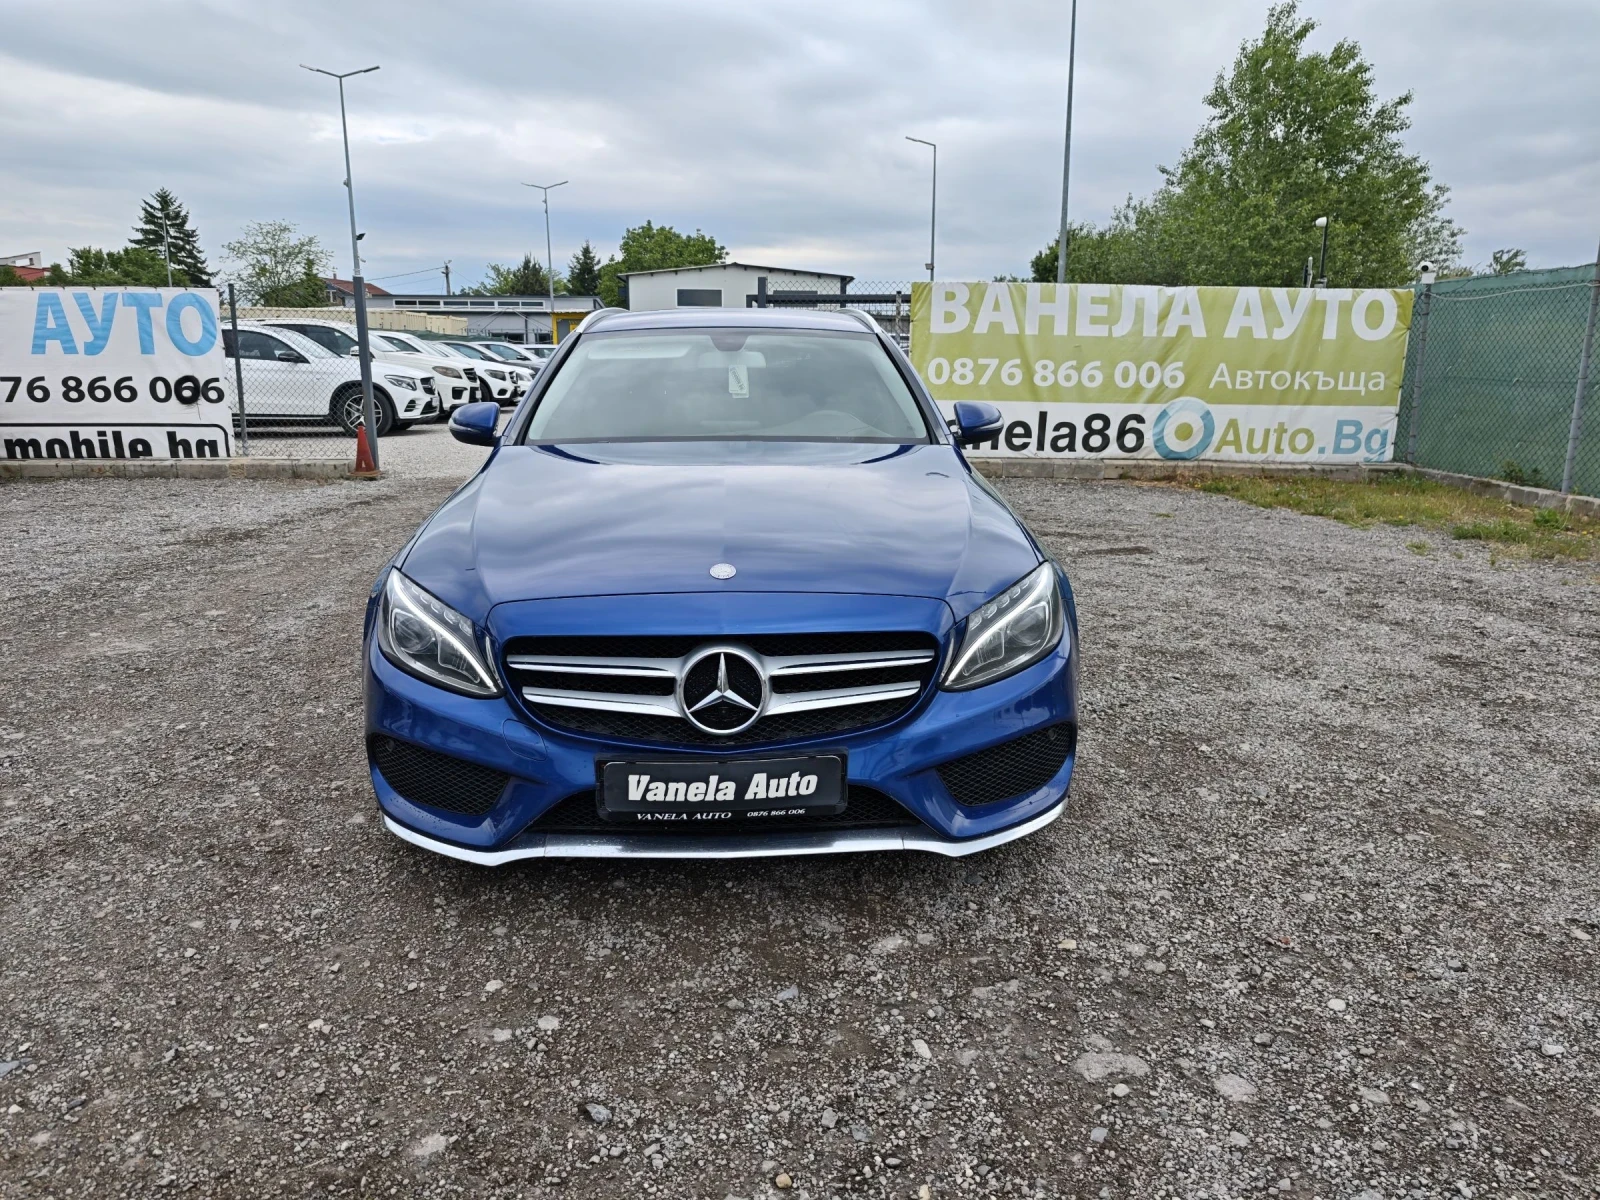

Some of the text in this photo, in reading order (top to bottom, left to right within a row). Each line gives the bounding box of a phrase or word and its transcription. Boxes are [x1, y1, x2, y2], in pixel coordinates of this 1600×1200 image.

[31, 292, 218, 356] АУТО
[929, 282, 1398, 341] ВАНЕЛА АУТО
[61, 376, 138, 403] 866
[927, 357, 1185, 389] 0876 866 006
[1208, 362, 1386, 396] Автокъща
[1212, 418, 1389, 463] Auto.Bg
[628, 771, 818, 802] Vanela Auto
[692, 812, 732, 820] AUTO
[747, 810, 769, 818] 0876
[770, 809, 787, 817] 866
[788, 808, 806, 816] 006
